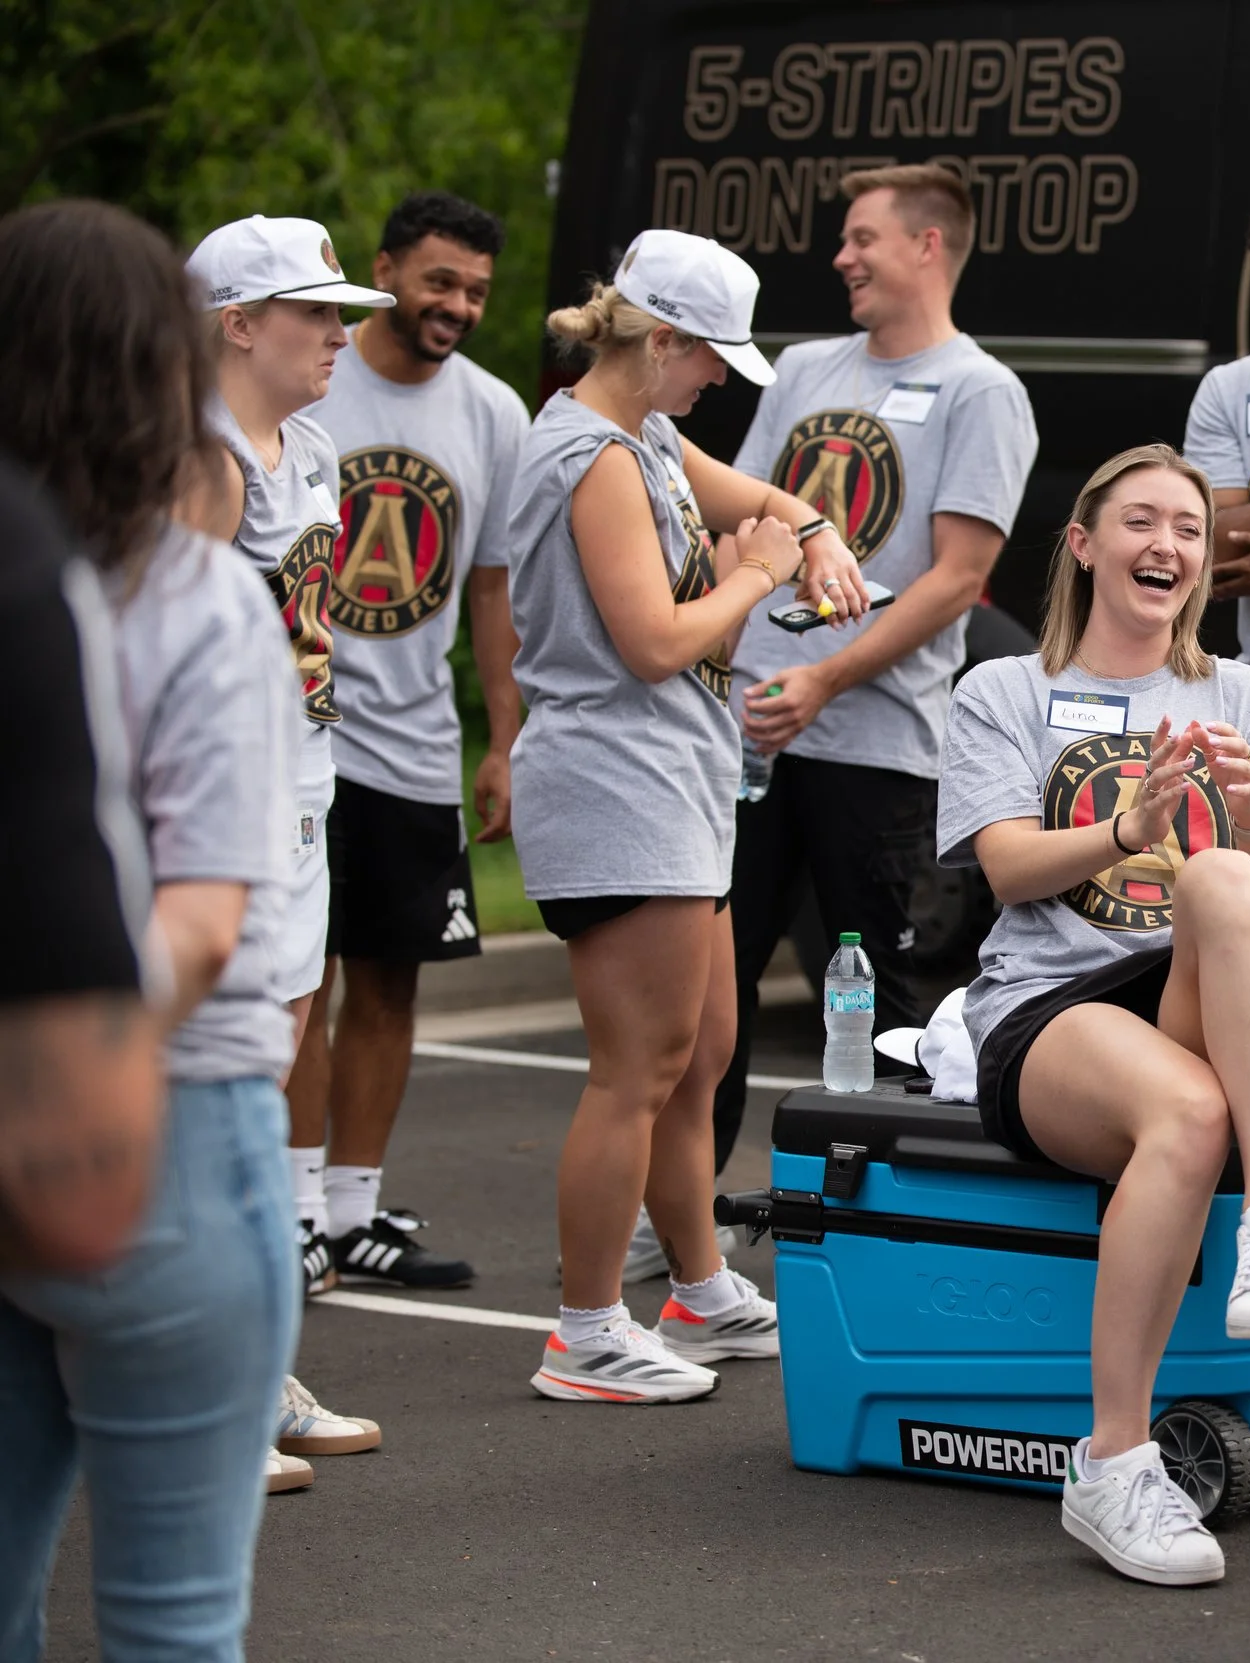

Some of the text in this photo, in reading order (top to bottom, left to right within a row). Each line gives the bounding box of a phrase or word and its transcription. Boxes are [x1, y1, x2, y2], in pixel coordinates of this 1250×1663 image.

[684, 37, 1125, 141] 5-STRIPES
[652, 156, 897, 255] DON'
[791, 416, 889, 461] ATLANTA
[408, 585, 441, 621] FC
[1060, 739, 1211, 786] ATLAA
[911, 1427, 1078, 1478] POWERAD
